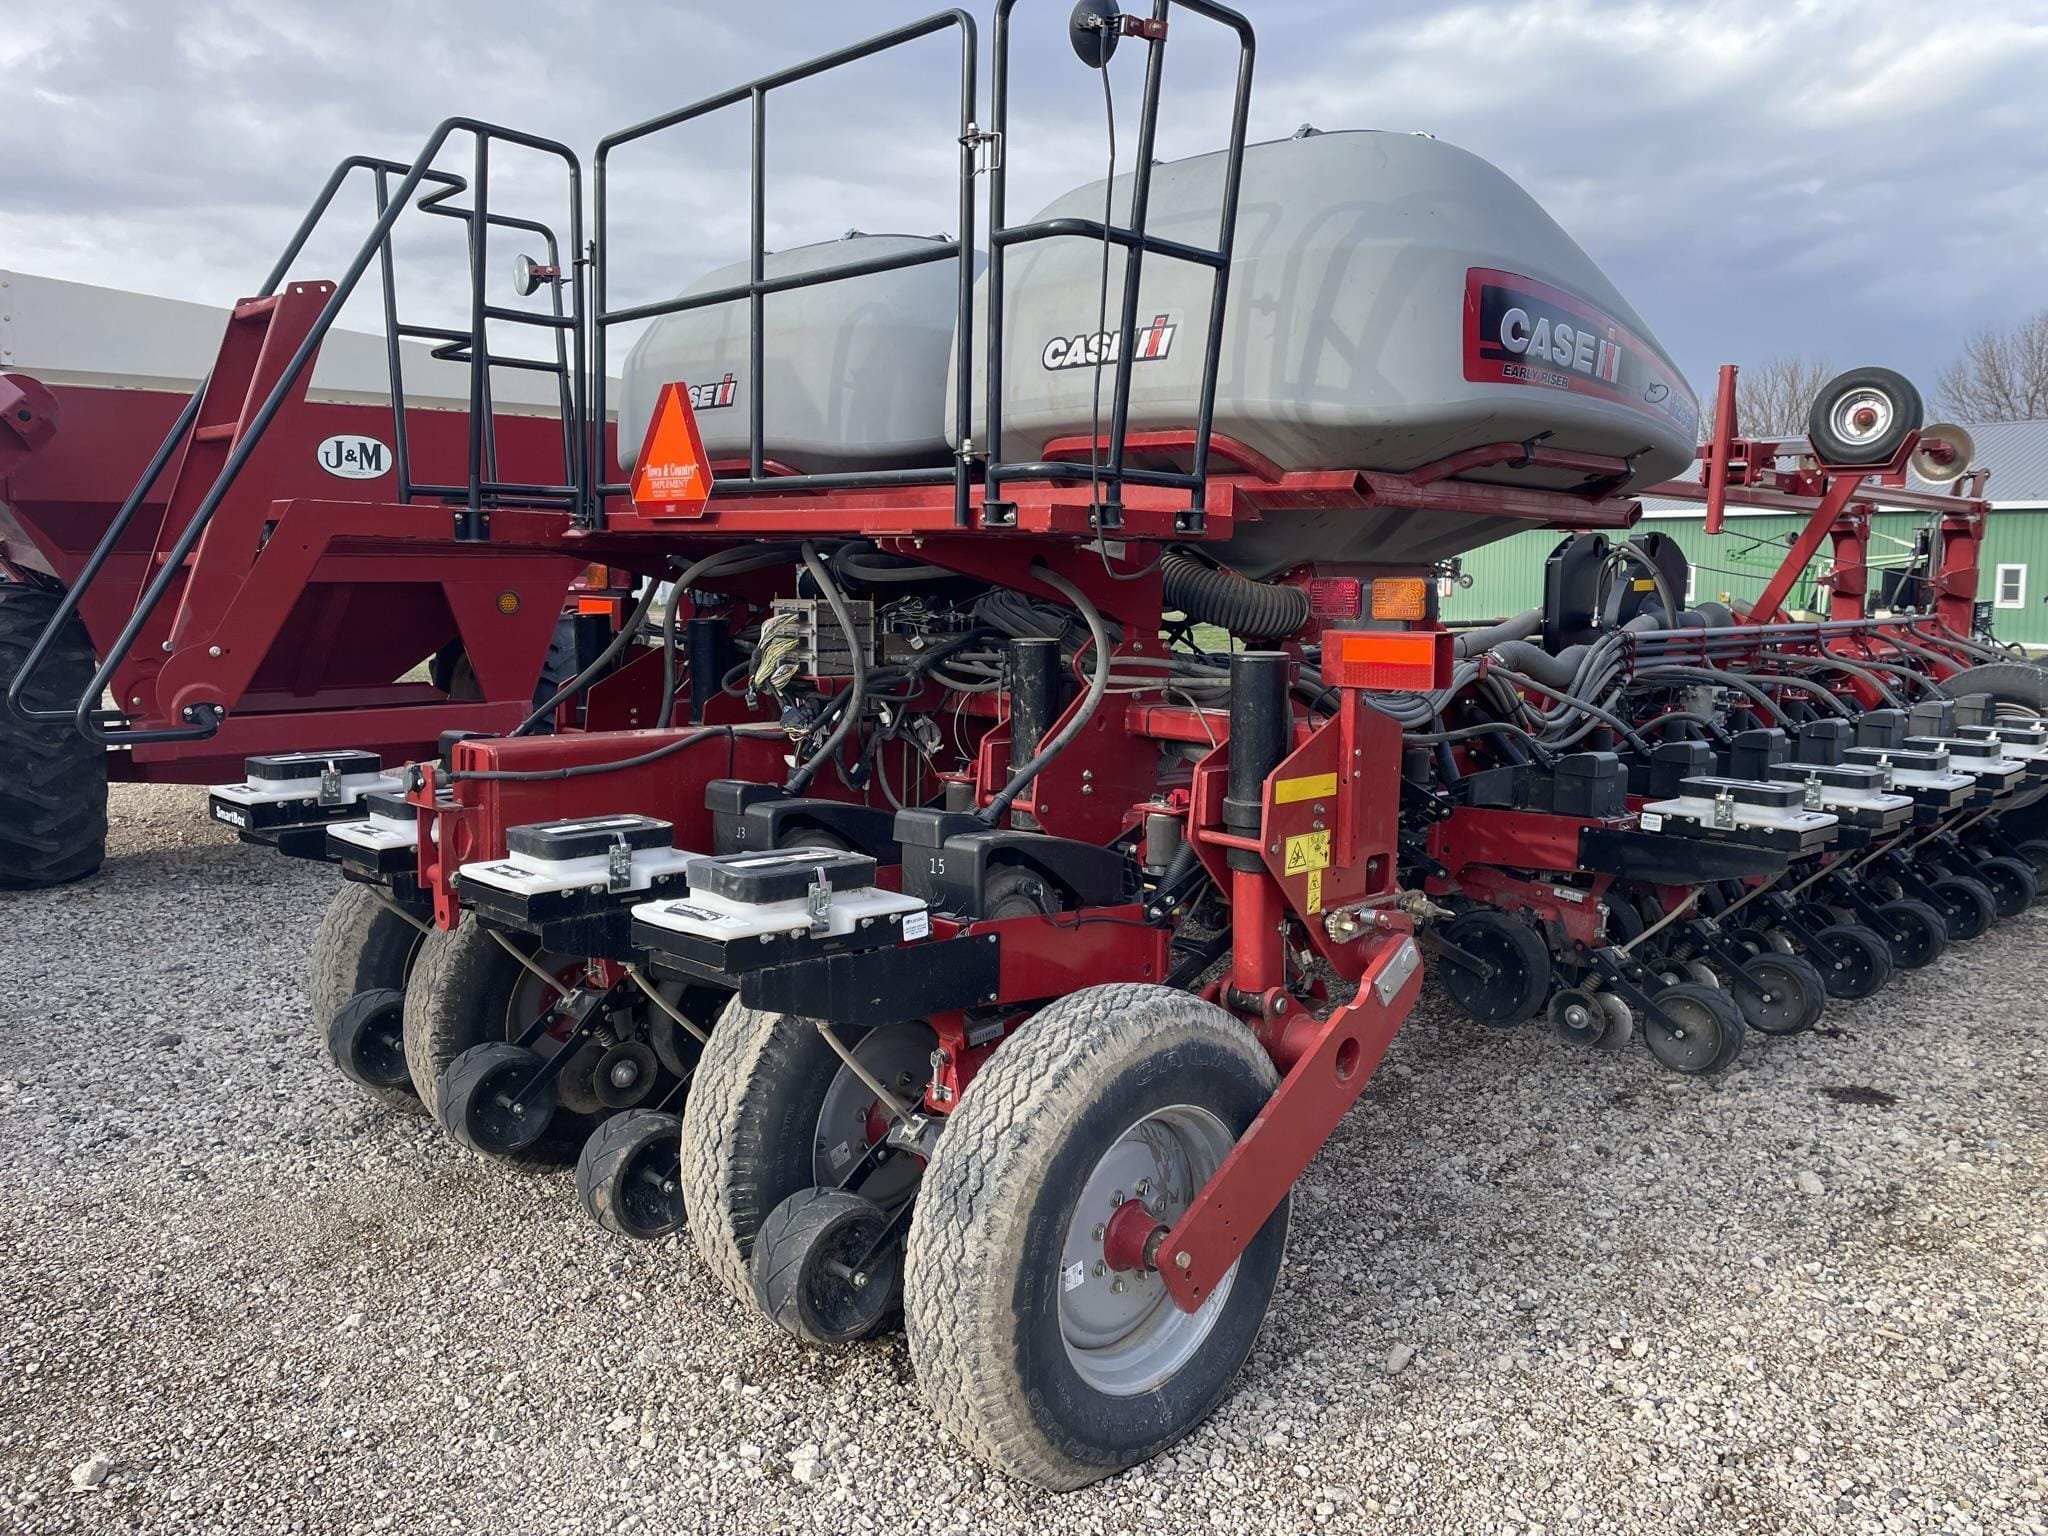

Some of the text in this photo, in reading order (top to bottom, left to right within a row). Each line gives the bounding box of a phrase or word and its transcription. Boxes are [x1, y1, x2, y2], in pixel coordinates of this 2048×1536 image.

[1501, 307, 1595, 377] CASE
[1503, 364, 1569, 389] EARLY RISER
[324, 441, 383, 471] J&M
[645, 464, 662, 477] Town
[651, 480, 688, 489] IMPLEMENT
[216, 805, 246, 828] SmartBox
[736, 826, 746, 839] 13
[929, 857, 945, 875] 15
